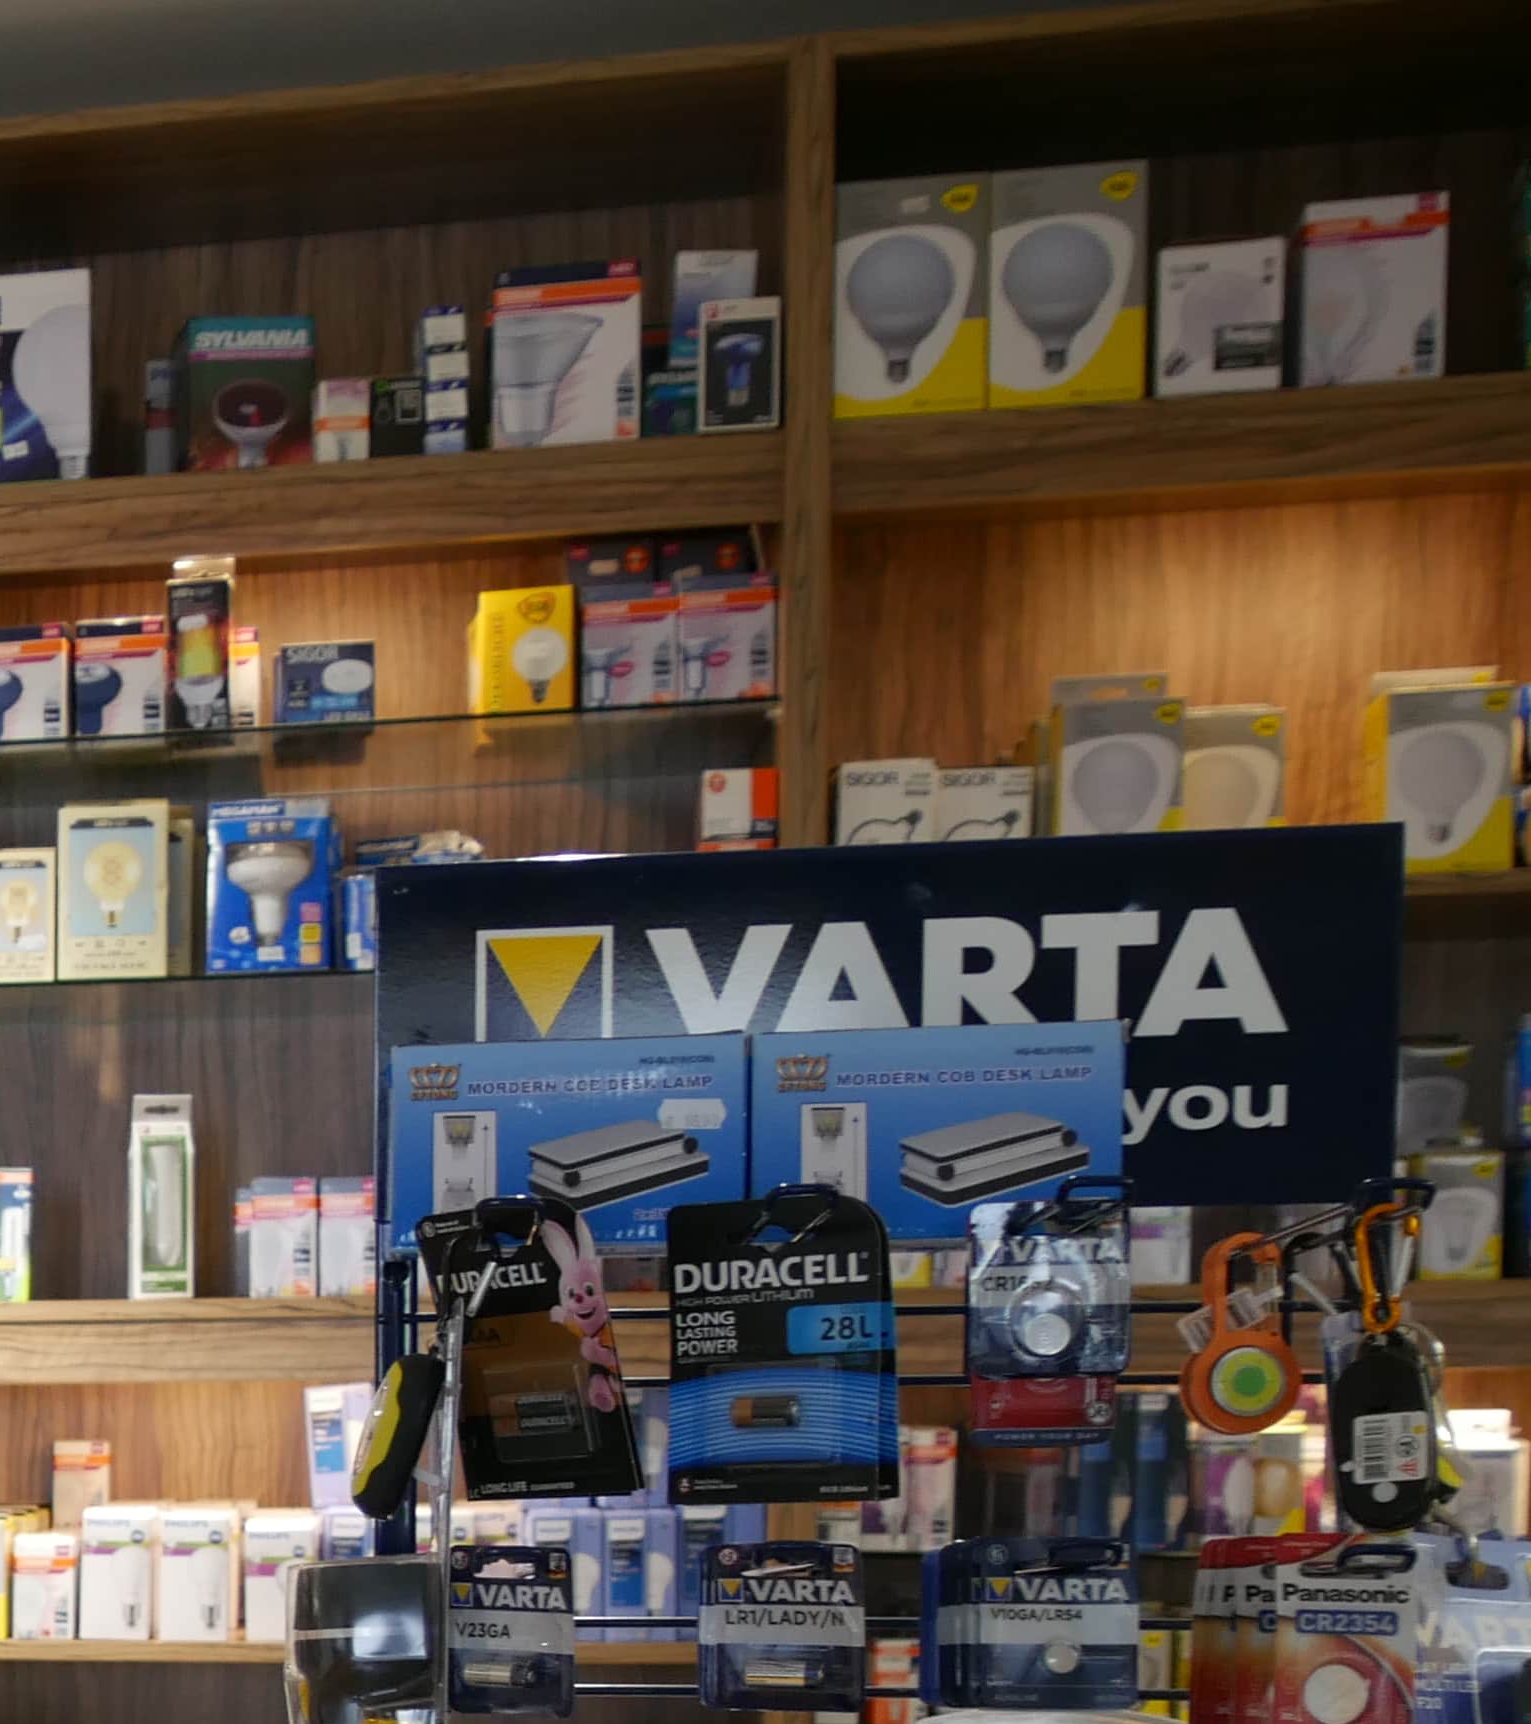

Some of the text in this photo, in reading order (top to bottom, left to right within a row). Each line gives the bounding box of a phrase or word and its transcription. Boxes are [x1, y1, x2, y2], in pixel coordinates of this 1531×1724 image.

[195, 329, 309, 348] SYLVANIA
[645, 907, 1288, 1037] VARTA
[837, 1072, 929, 1087] MORDERN
[938, 1071, 975, 1084] COB
[983, 1069, 1032, 1083] DESK
[1040, 1067, 1092, 1081] LAMP
[1122, 1084, 1288, 1144] you
[674, 1253, 870, 1293] DURACELL
[676, 1311, 735, 1326] LONG
[821, 1315, 873, 1340] 28L
[676, 1326, 736, 1339] LASTING
[676, 1340, 738, 1356] POWER
[478, 1584, 567, 1610] VARTA
[748, 1579, 855, 1603] VARTA
[1014, 1577, 1130, 1601] VARTA
[1283, 1583, 1410, 1605] Panasonic
[725, 1610, 845, 1628] LR1/LADY/N
[990, 1608, 1083, 1623] V10GA/LR54
[1297, 1613, 1394, 1634] CR2354
[455, 1622, 510, 1639] V23GA
